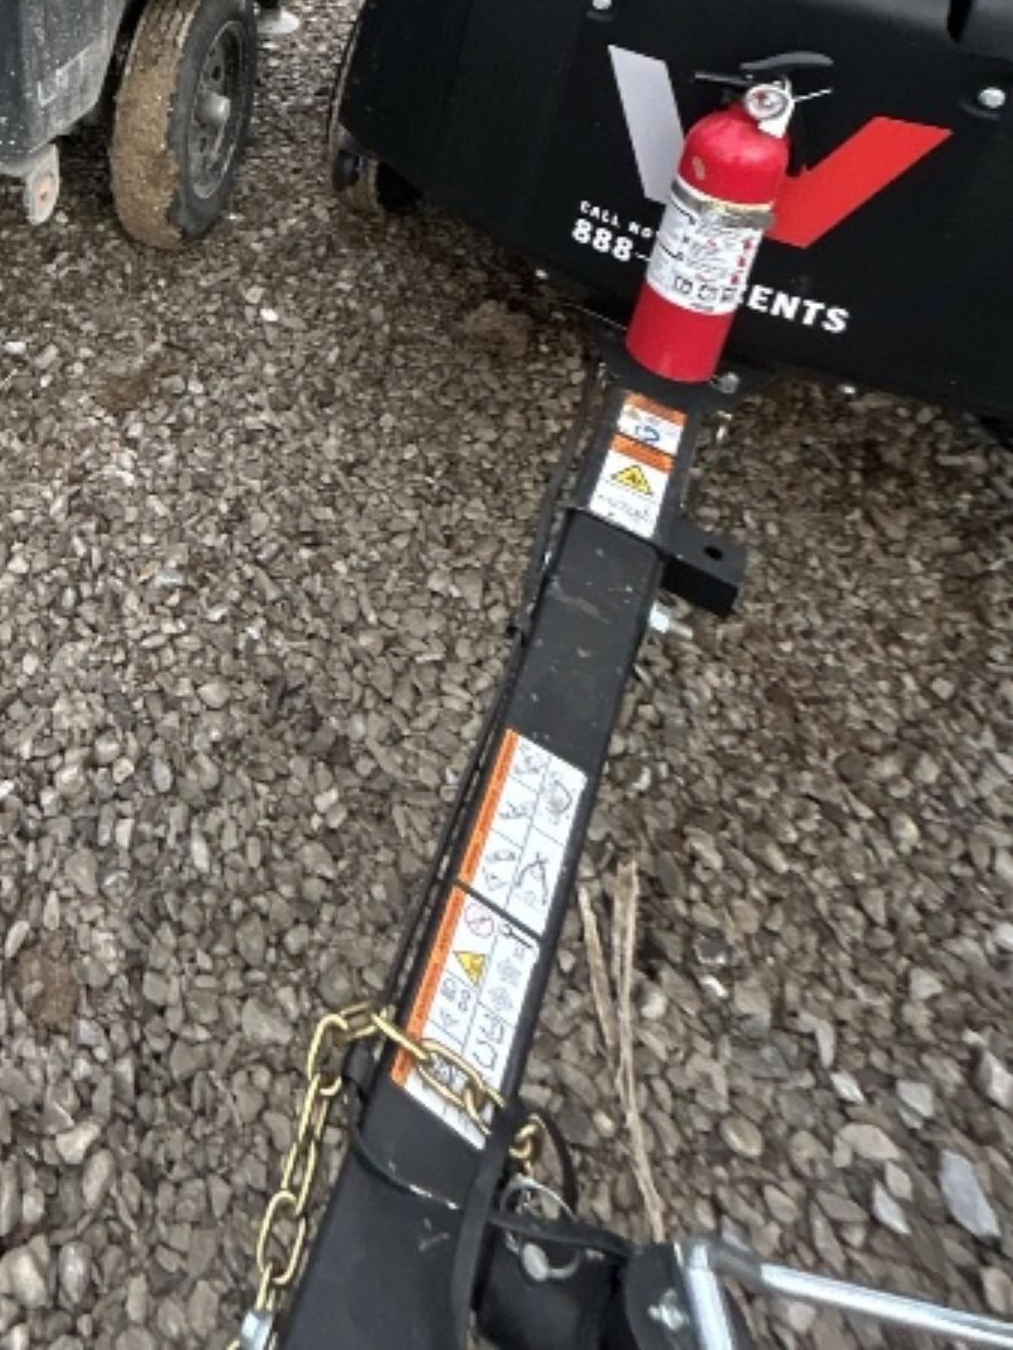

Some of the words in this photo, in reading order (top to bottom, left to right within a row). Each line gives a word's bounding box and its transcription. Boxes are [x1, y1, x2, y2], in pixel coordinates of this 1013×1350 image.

[579, 200, 621, 228] CALL
[628, 221, 655, 239] NO
[742, 284, 851, 334] ENTS
